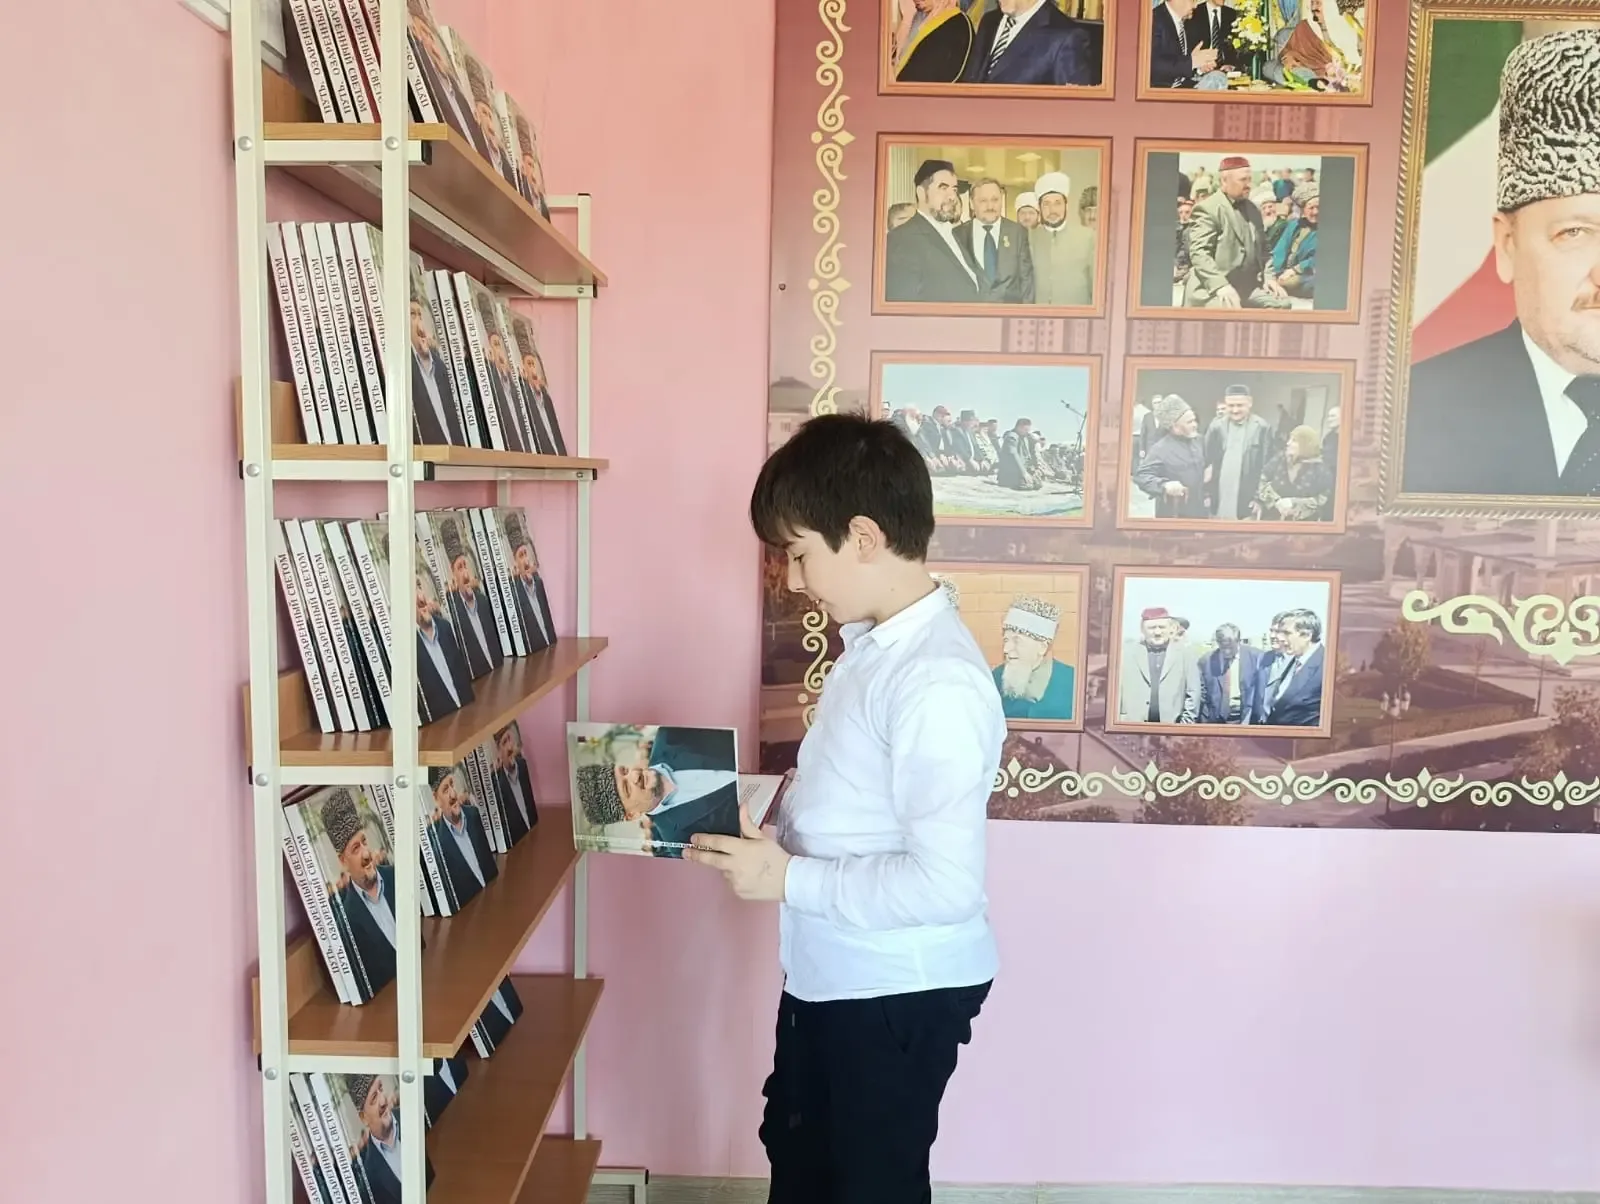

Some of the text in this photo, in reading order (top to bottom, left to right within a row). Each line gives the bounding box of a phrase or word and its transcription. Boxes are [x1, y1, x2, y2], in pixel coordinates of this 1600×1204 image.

[295, 5, 320, 76] ОЗАРЕННЫЙ
[313, 4, 340, 76] ОЗАРЕННЫЙ
[326, 0, 368, 112] ЗАРЕННЫЙ СВЕТОМ
[274, 258, 290, 302] СВЕТОМ
[292, 257, 308, 302] СВЕТОМ
[312, 258, 326, 302] СВЕТОМ
[326, 256, 340, 301] СВЕТОМ
[346, 258, 360, 302] СВЕТОМ
[362, 258, 379, 302] СВЕТОМ
[281, 305, 305, 374] ОЗАРЕННЫЙ
[300, 304, 321, 374] ОЗАРЕННЫЙ
[334, 303, 355, 373] ОЗАРЕННЫЙ
[444, 299, 456, 336] СВЕТОМ
[463, 300, 476, 338] СВЕТОМ
[320, 306, 340, 376] ОЗАРЕННЫЙ
[353, 306, 376, 376] ОЗАРЕННЫЙ
[476, 531, 488, 560] СВЕТОМ
[278, 554, 296, 596] СВЕТОМ
[296, 552, 315, 594] СВЕТОМ
[314, 554, 332, 596] СВЕТОМ
[338, 556, 358, 597] СВЕТОМ
[360, 554, 380, 596] СВЕТОМ
[288, 599, 314, 665] ОЗАРЕННЫЙ
[308, 597, 334, 663] ОЗАРЕННЫЙ
[324, 598, 350, 664] ОЗАРЕННЫЙ
[351, 598, 379, 664] ОЗАРЕННЫЙ
[284, 836, 304, 877] СВЕТОМ
[297, 834, 316, 876] СВЕТОМ
[298, 878, 328, 940] ОЗАРЕННЫЙ
[309, 877, 338, 940] ОЗАРЕННЫЙ
[322, 1102, 340, 1142] СВЕТОМ
[303, 1102, 342, 1204] ОЗАРЕННЫЙ СВЕТОМ
[295, 1149, 321, 1204] ЗАРЕННЫЙ
